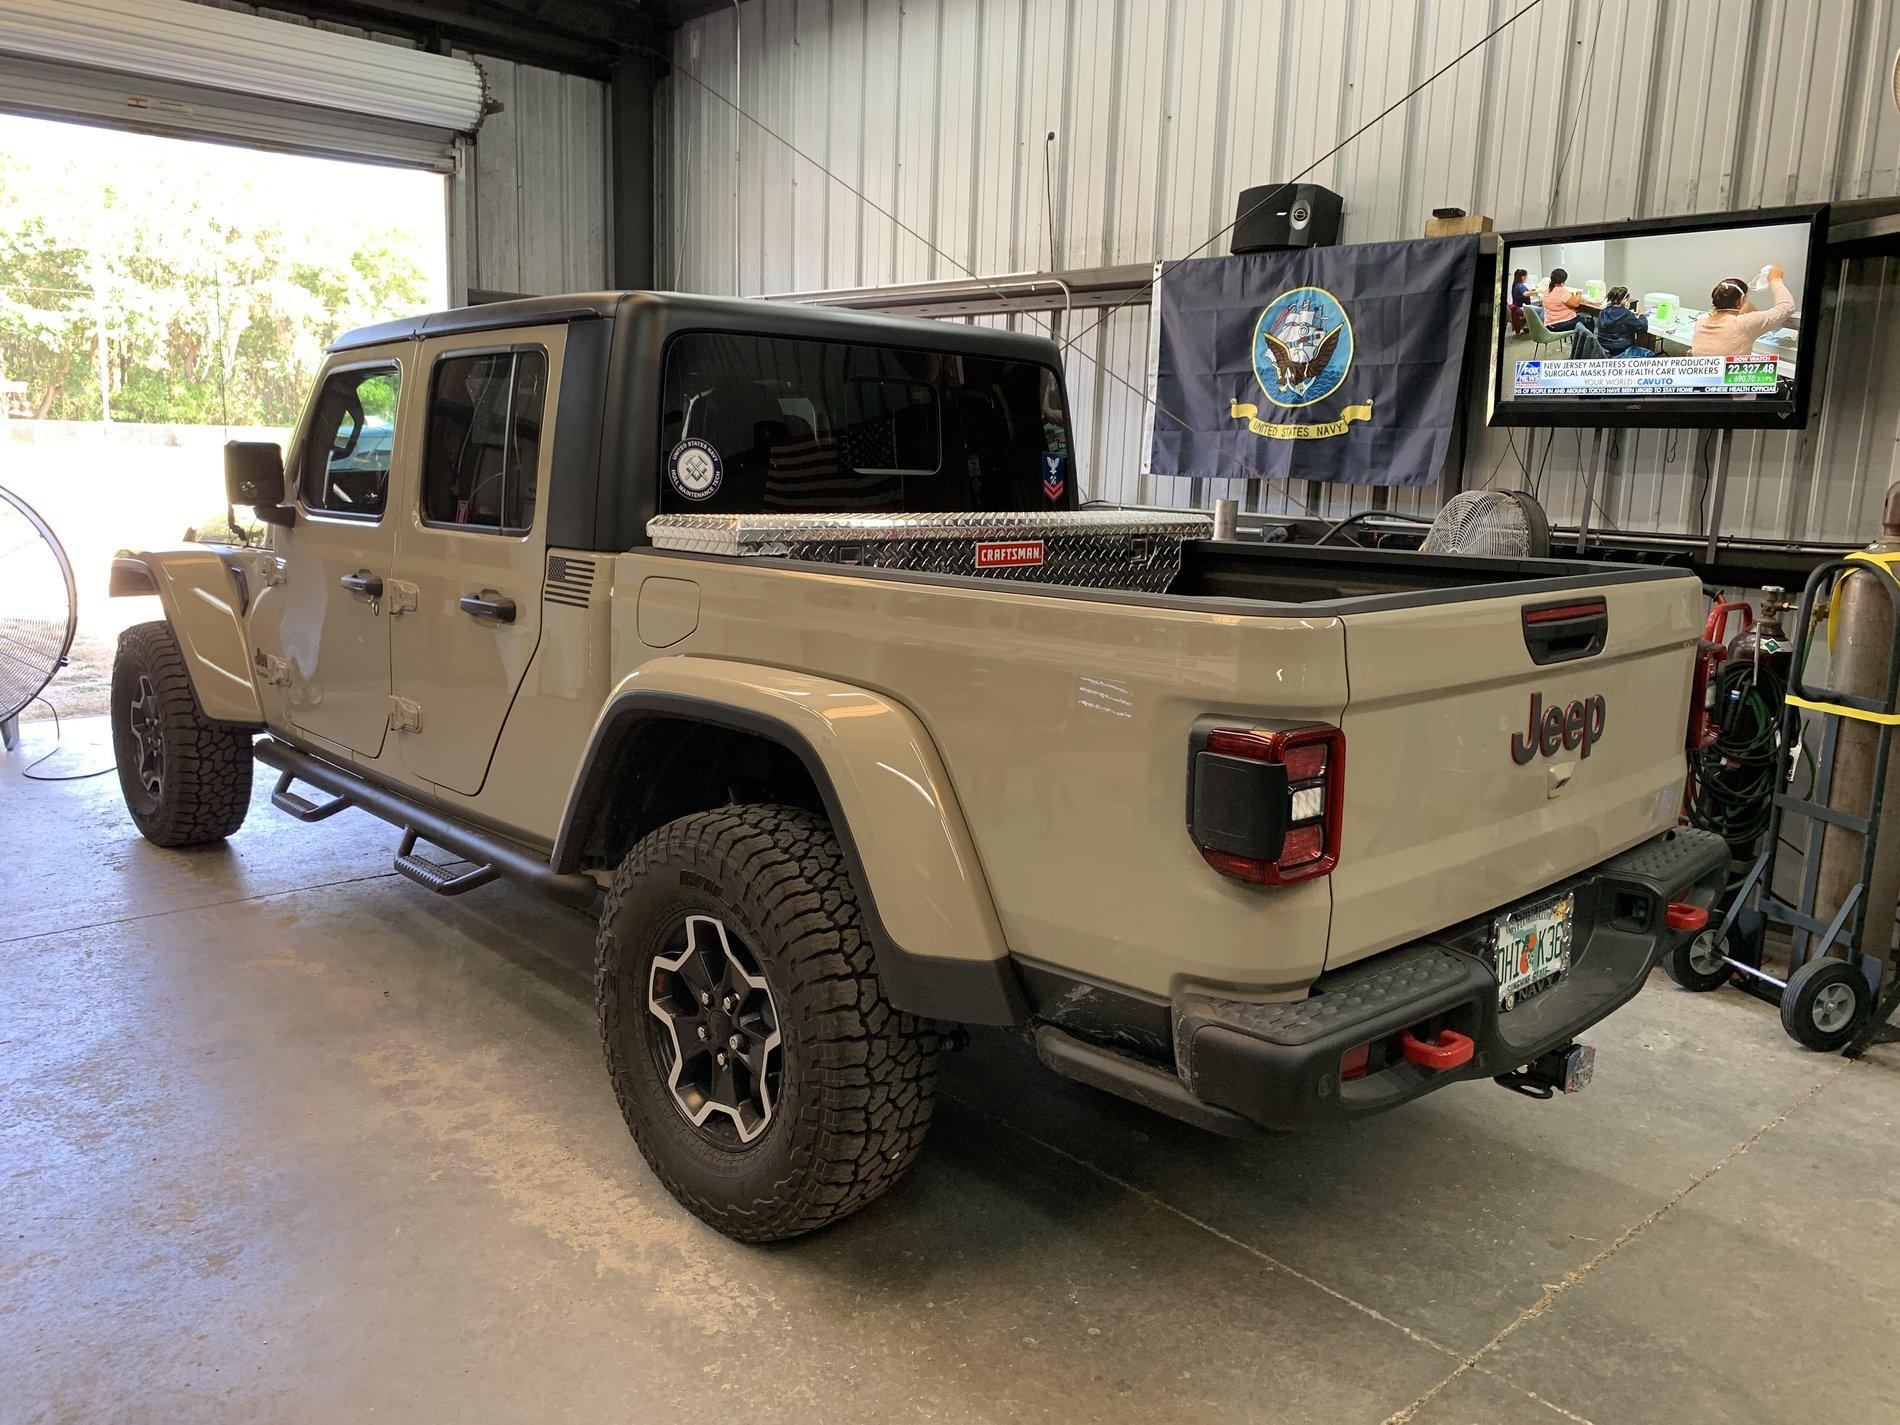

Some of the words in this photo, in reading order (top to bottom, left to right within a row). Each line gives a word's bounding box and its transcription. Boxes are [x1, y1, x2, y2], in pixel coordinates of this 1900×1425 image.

[1588, 360, 1626, 368] MATTRESS
[1628, 359, 1668, 368] COMPANY
[1670, 358, 1720, 366] PRODUCING
[1524, 367, 1540, 375] FOX
[1544, 370, 1579, 378] SURGICAL
[1656, 367, 1676, 375] CARE
[1678, 366, 1718, 375] WORKERS
[1252, 421, 1278, 436] UNITED
[1281, 426, 1310, 437] STATES
[1316, 423, 1342, 436] NAVY
[672, 443, 688, 460] UNITED
[688, 441, 708, 450] STATES
[707, 447, 718, 462] NAVY
[671, 469, 680, 486] HULL
[678, 486, 714, 498] MAINTENANCE
[712, 471, 721, 487] TECH
[981, 547, 1040, 562] CRAFTSMAN
[1511, 691, 1606, 766] Jeep
